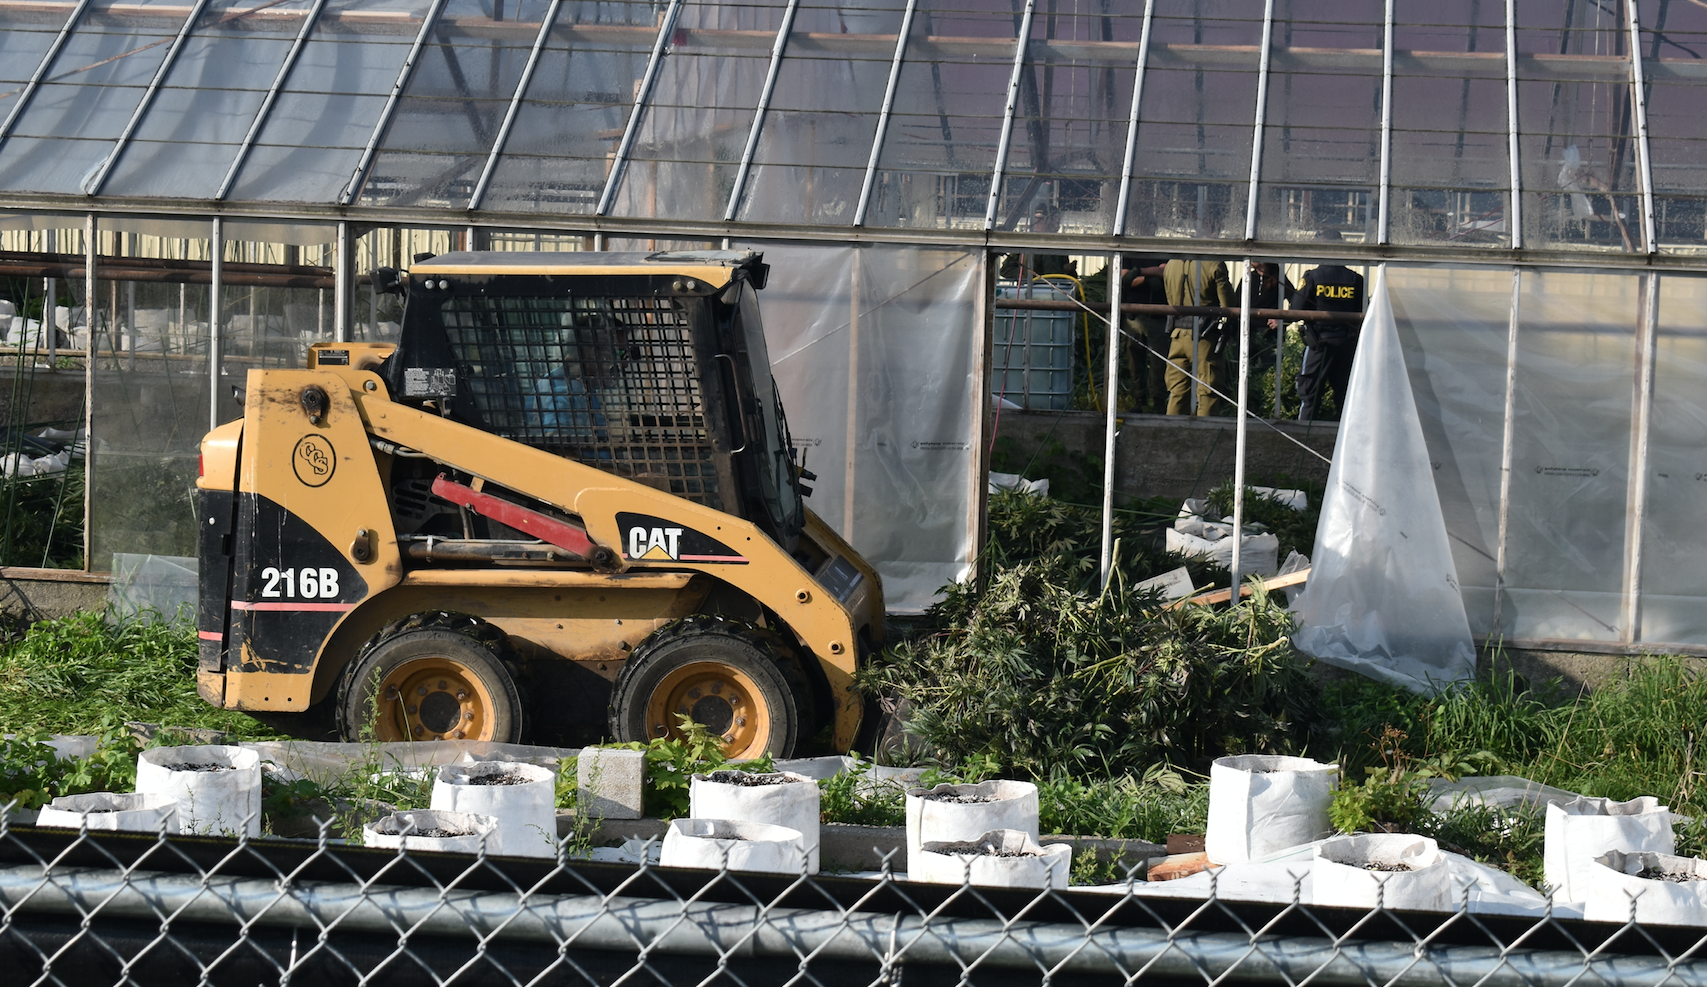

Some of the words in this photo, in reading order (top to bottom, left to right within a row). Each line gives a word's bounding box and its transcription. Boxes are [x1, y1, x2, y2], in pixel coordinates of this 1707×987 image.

[1316, 284, 1355, 298] POLICE
[629, 526, 682, 560] CAT
[261, 567, 340, 599] 216B
